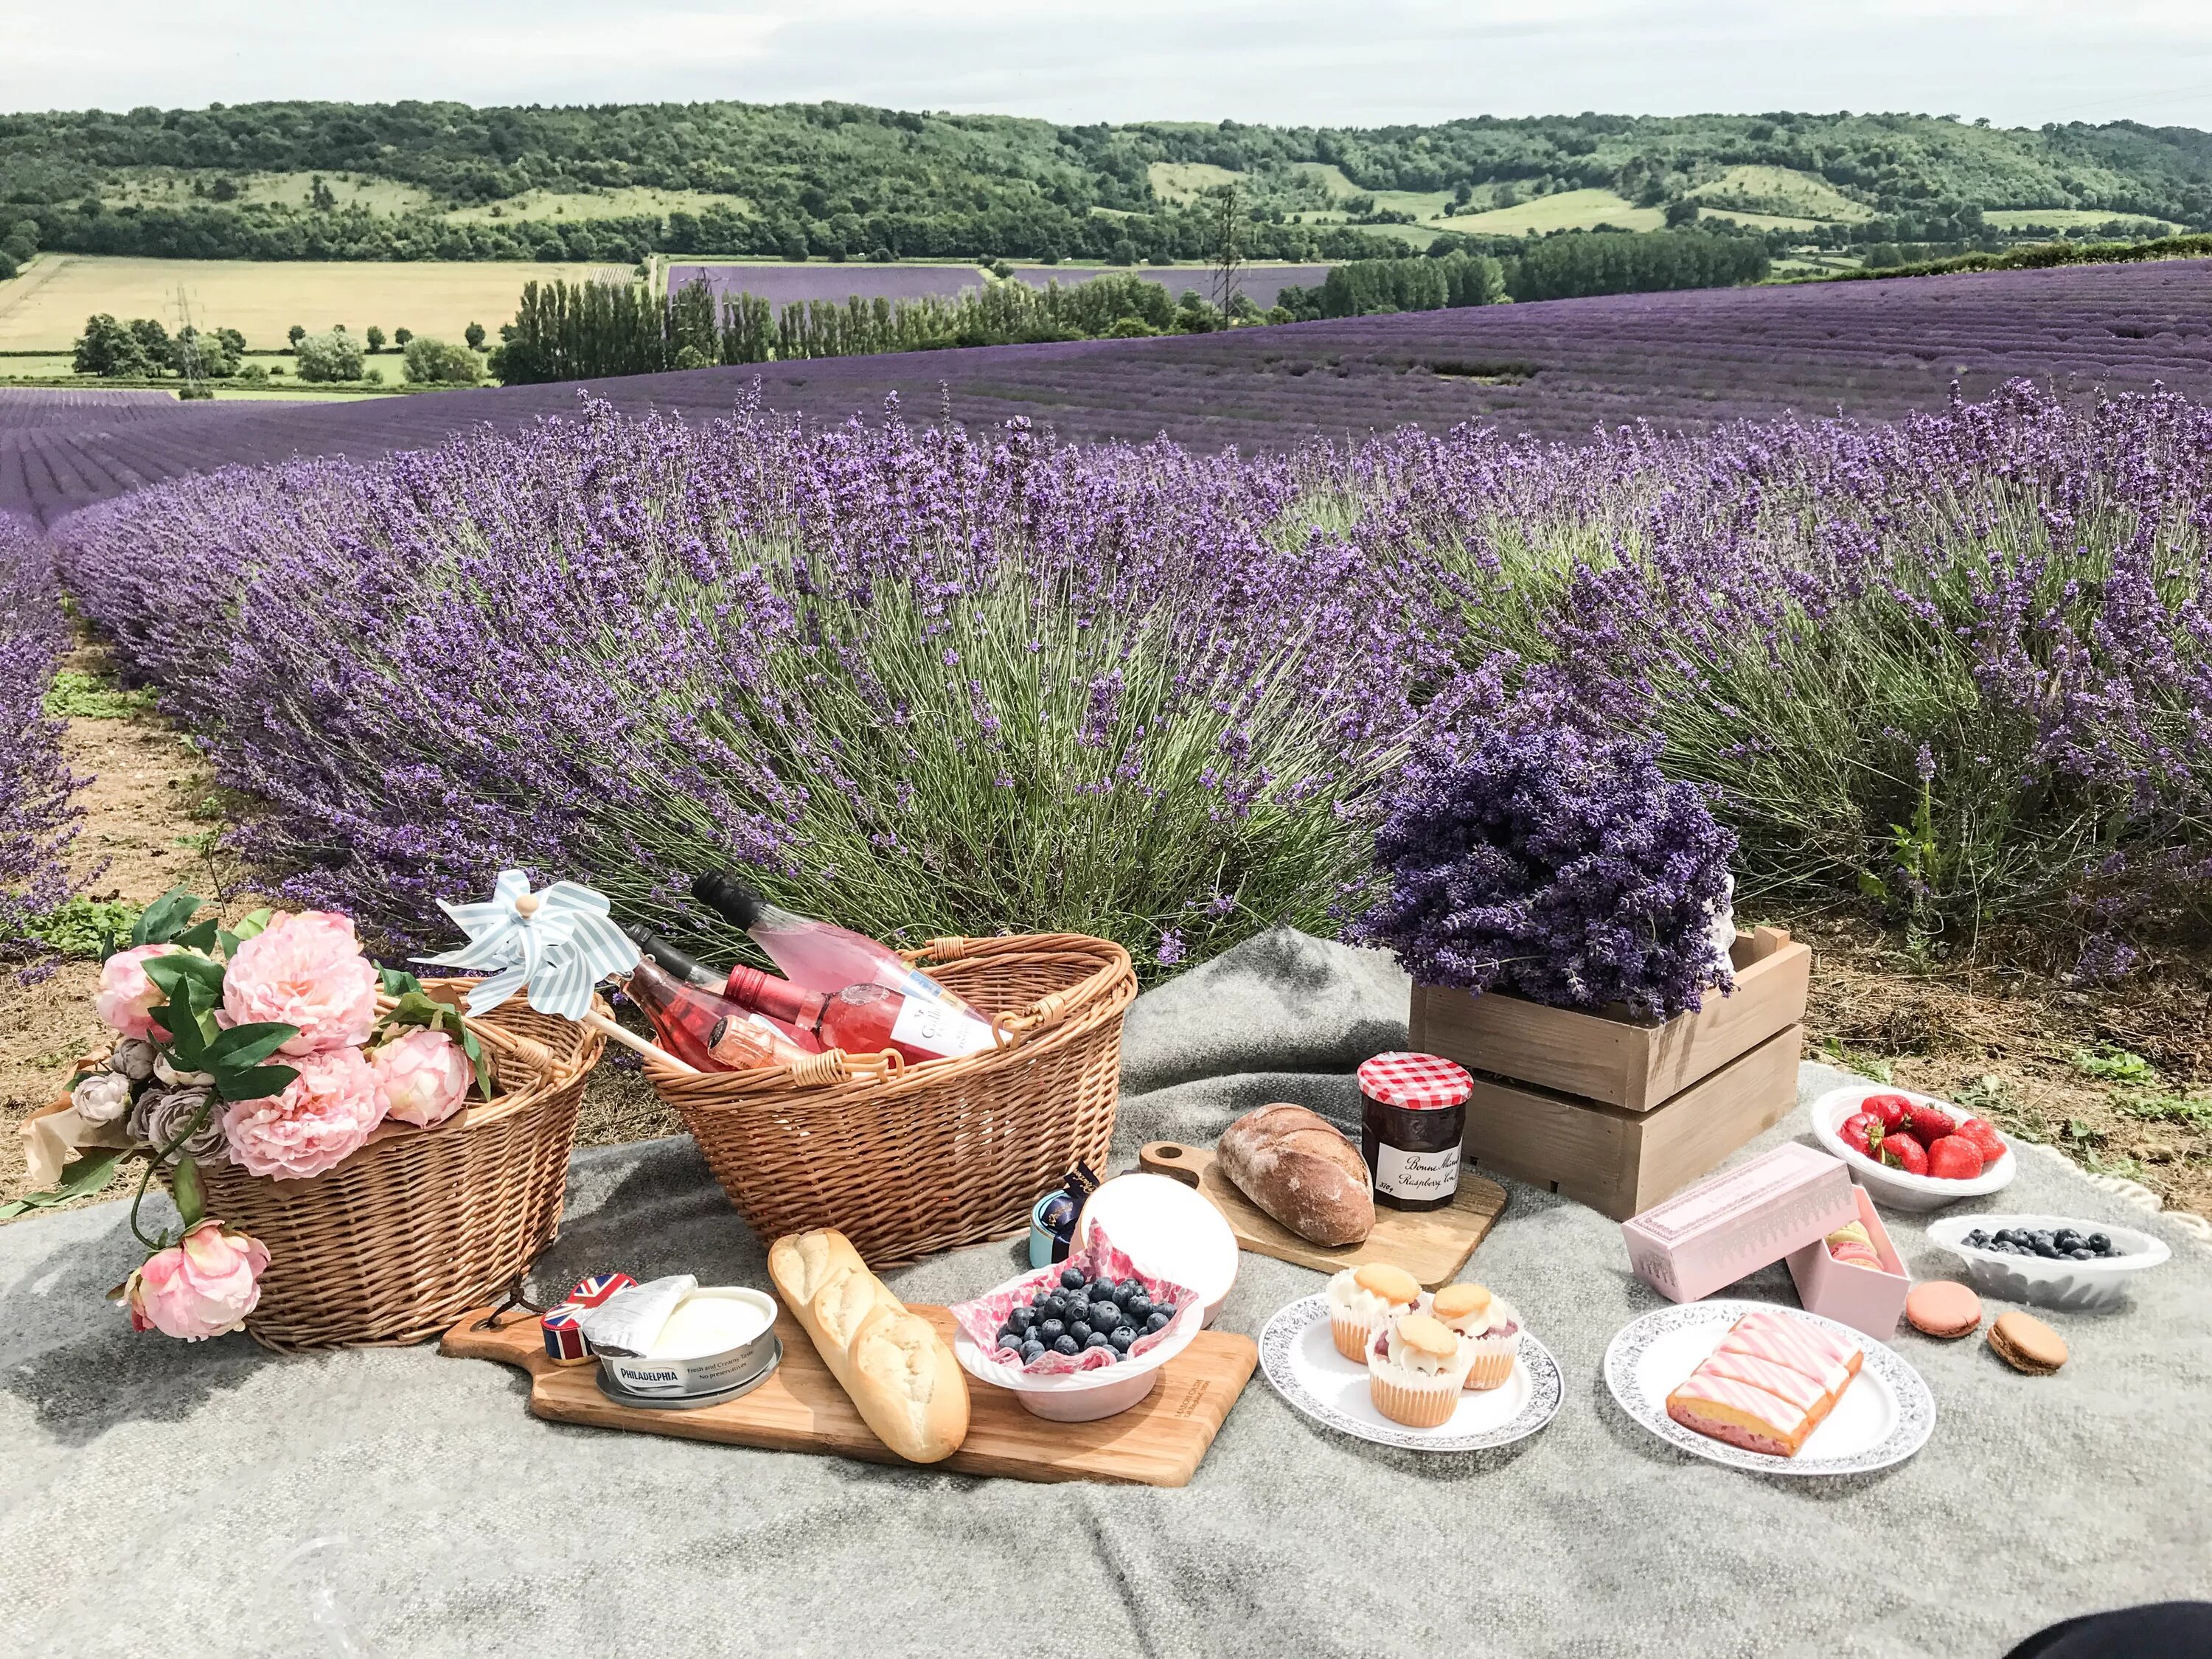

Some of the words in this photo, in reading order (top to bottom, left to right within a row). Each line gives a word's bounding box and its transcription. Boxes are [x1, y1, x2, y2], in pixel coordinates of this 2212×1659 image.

[1405, 1155, 1437, 1171] Bonne
[1399, 1173, 1441, 1190] Raspberry
[717, 1357, 740, 1368] Creamy
[740, 1350, 754, 1360] Taste
[620, 1368, 678, 1381] PHILADELPHIA
[710, 1363, 747, 1380] preservatives
[1174, 1395, 1193, 1417] MASON
